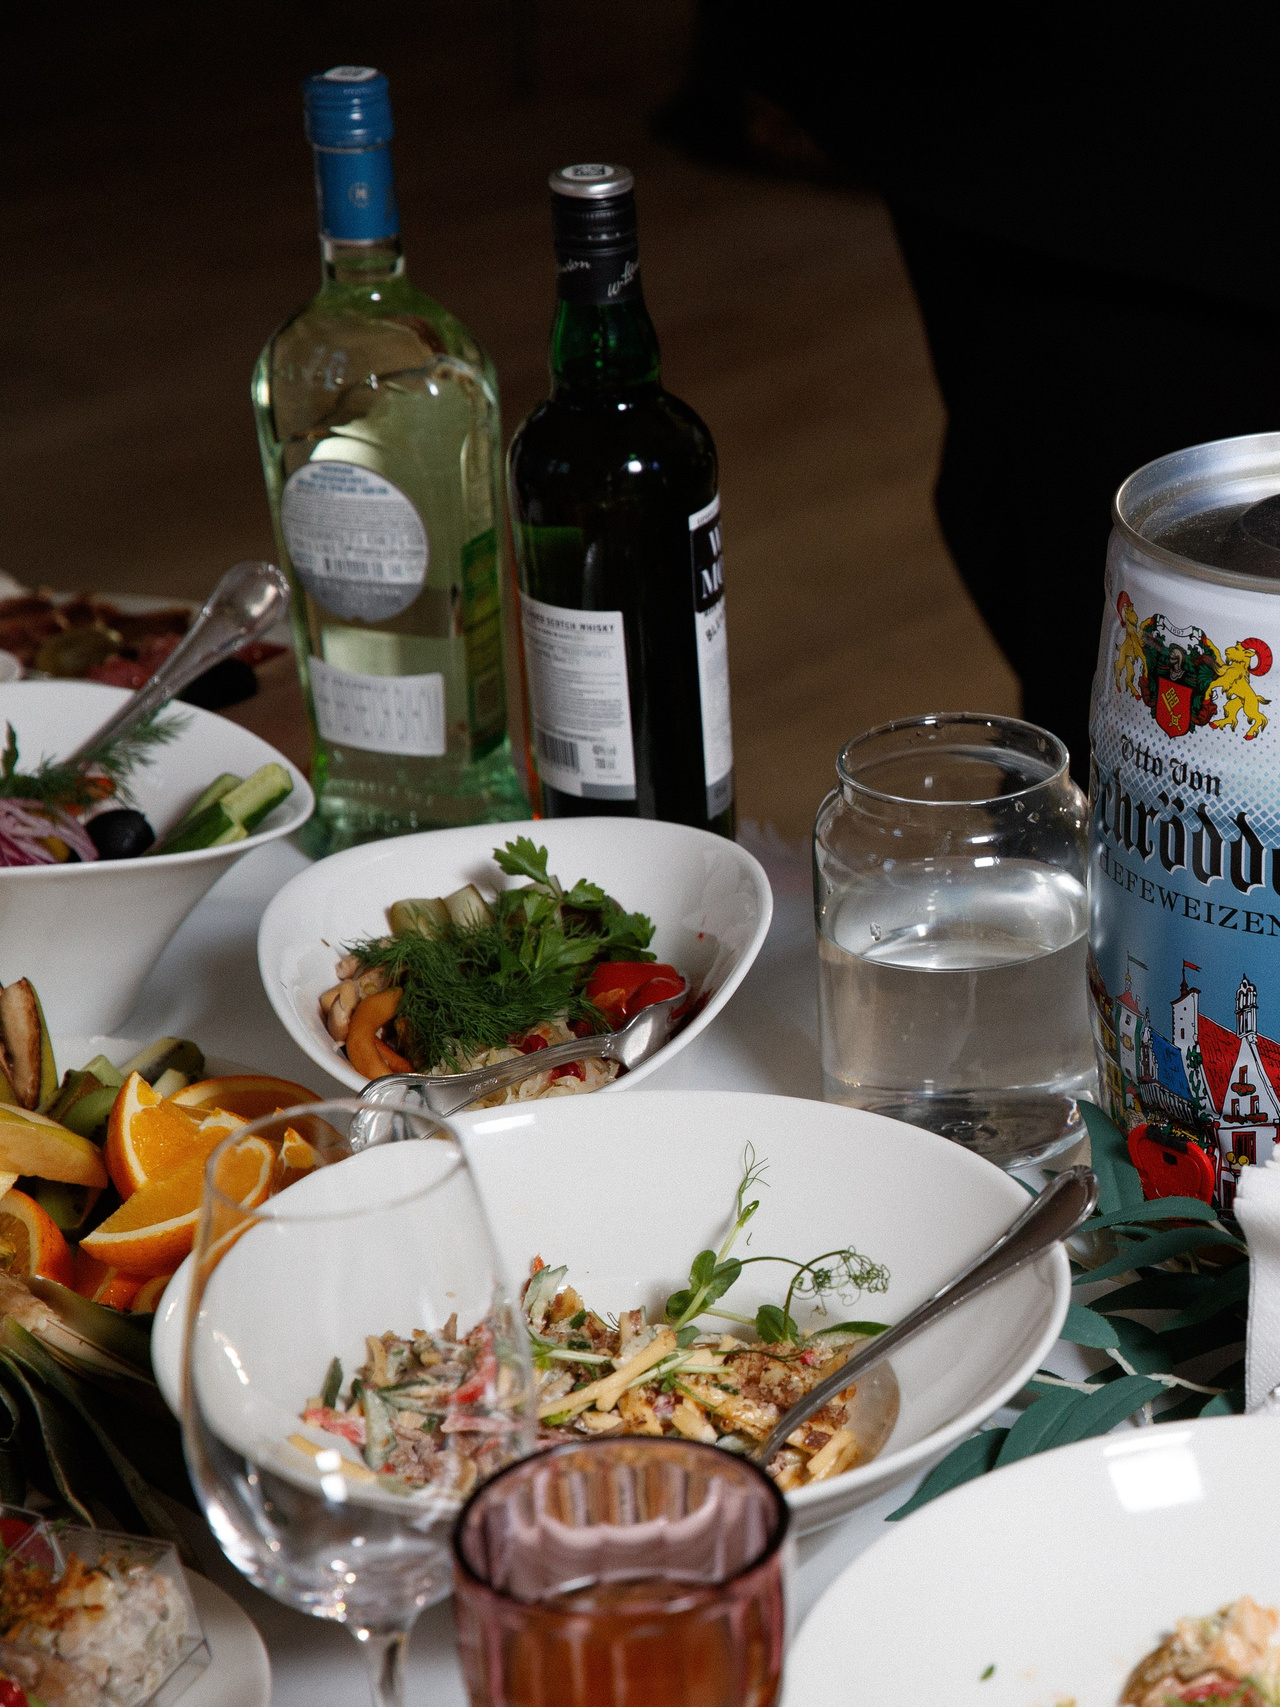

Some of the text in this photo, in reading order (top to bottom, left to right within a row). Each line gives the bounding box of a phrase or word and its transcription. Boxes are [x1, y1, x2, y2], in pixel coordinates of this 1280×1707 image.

[580, 624, 614, 633] WHISKY
[1121, 734, 1222, 796] Otto Von
